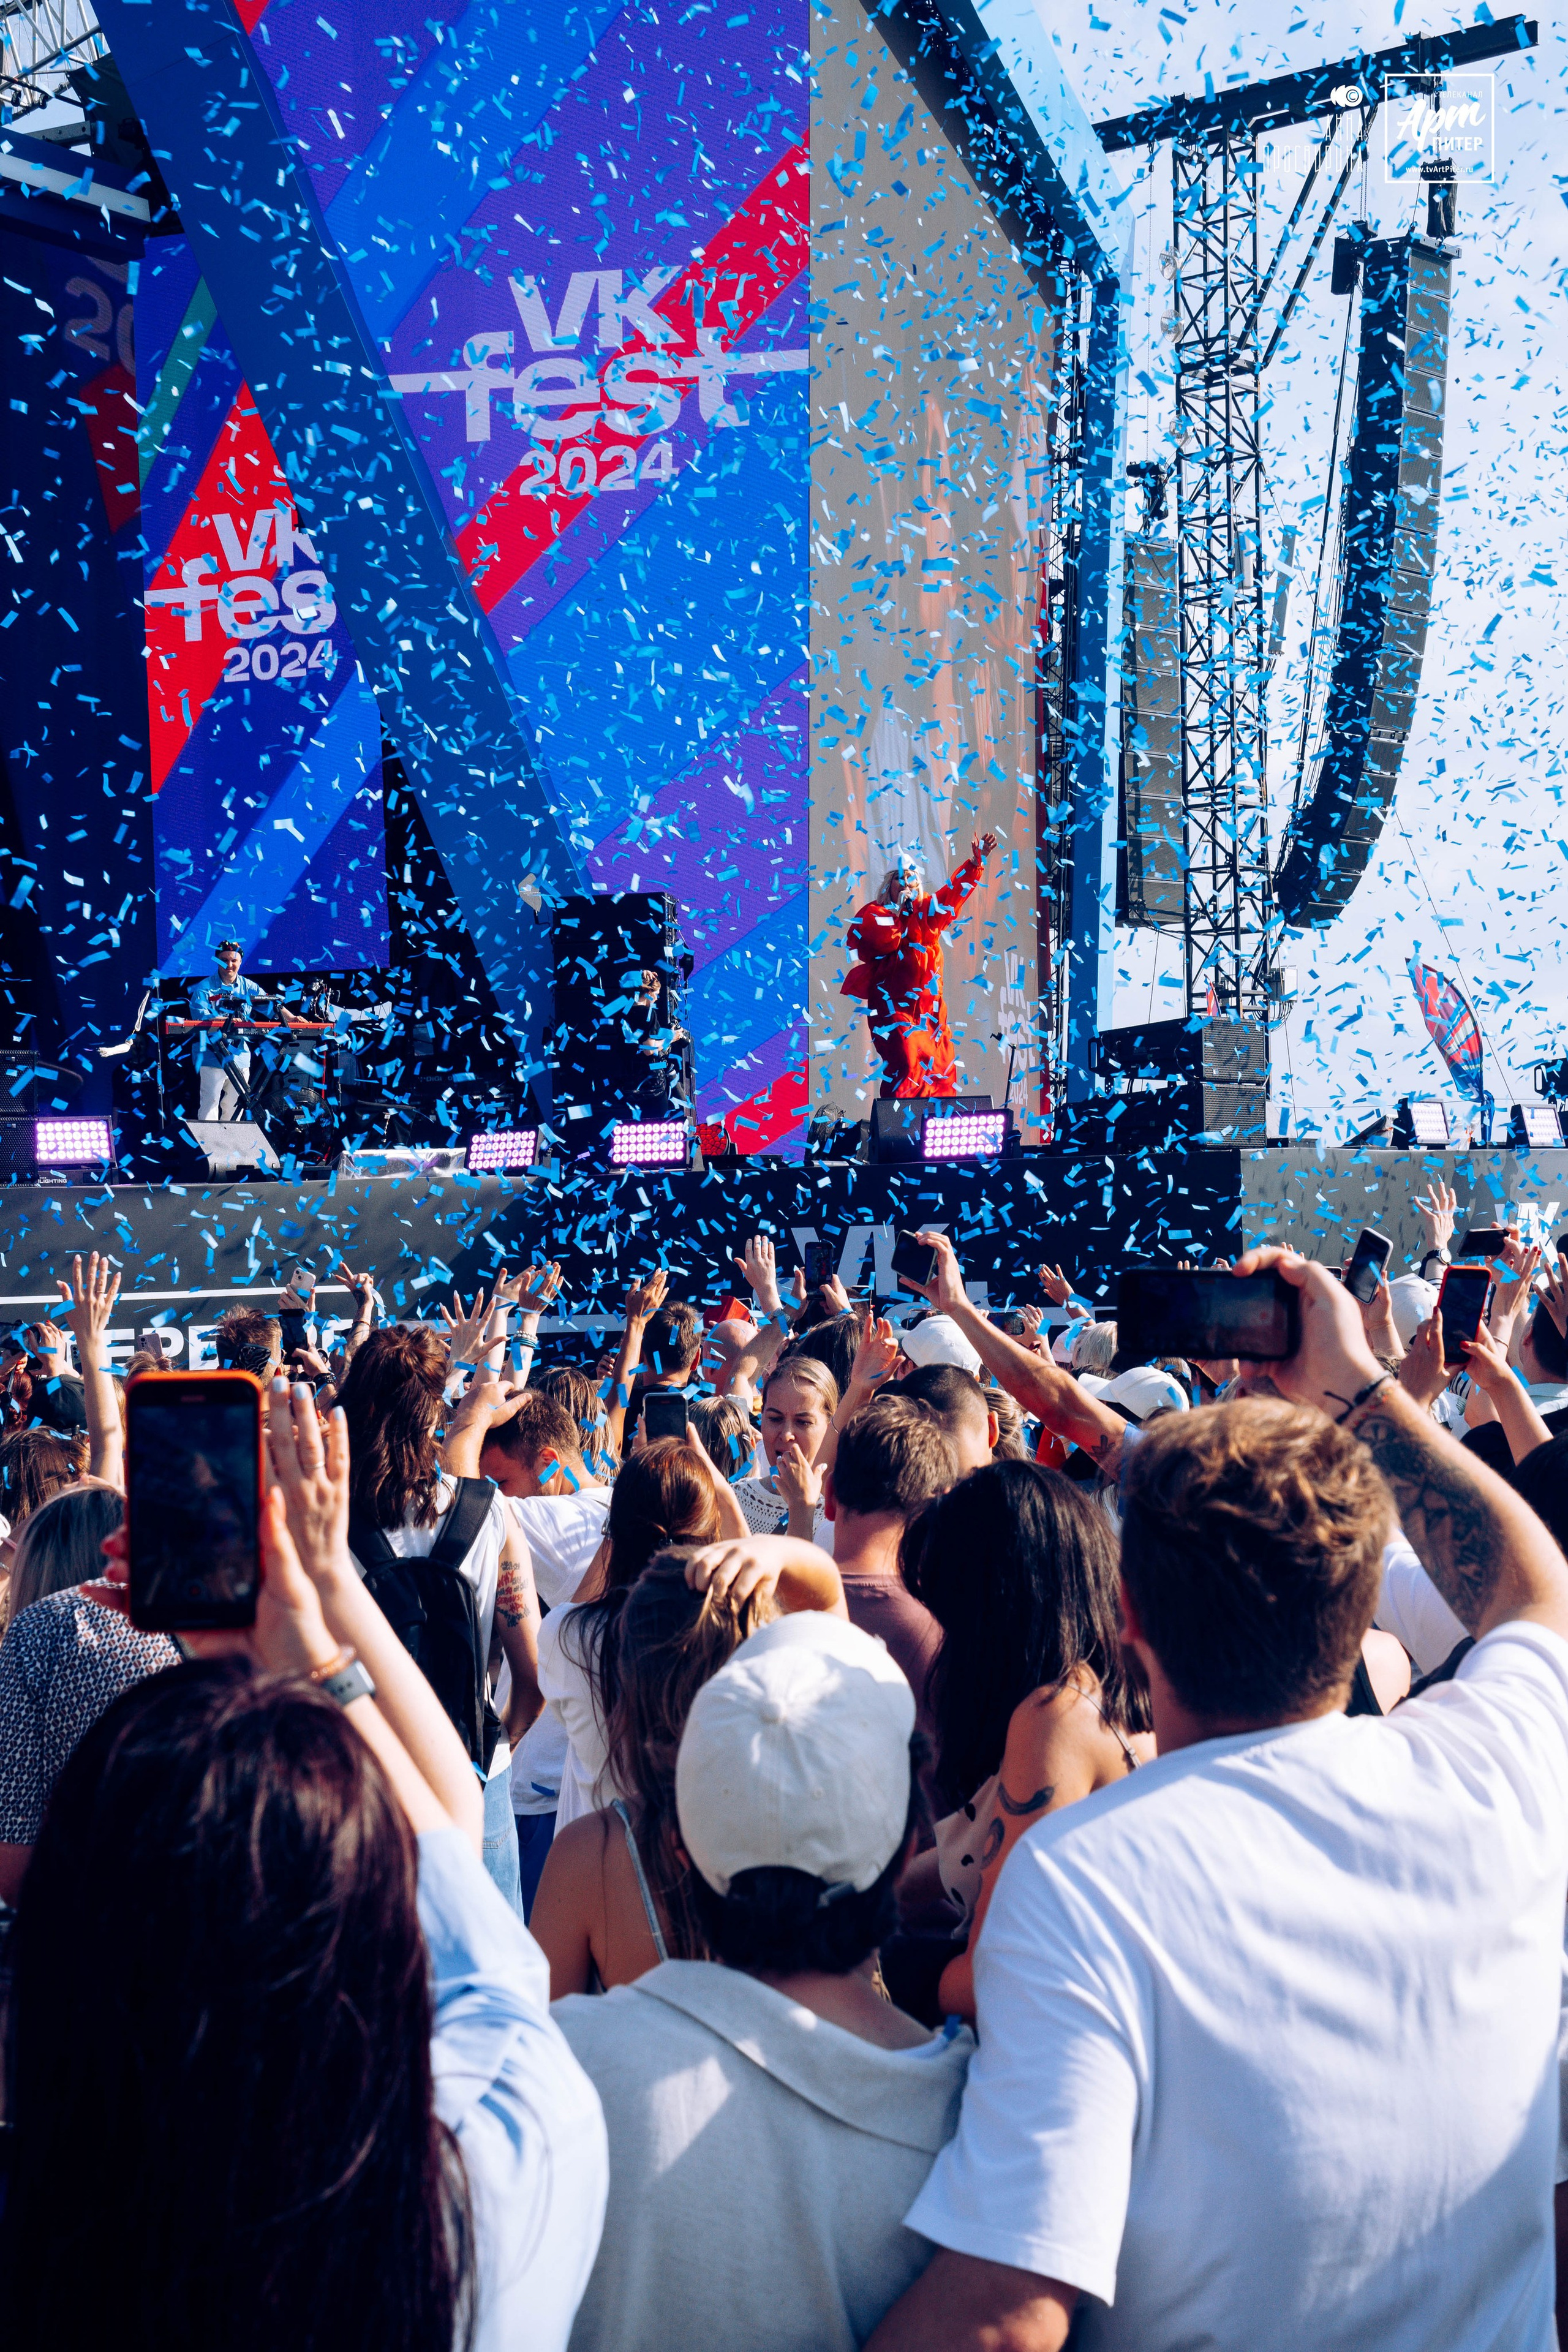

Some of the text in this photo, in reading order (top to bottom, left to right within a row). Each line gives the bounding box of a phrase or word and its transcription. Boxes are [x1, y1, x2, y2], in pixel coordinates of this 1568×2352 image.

[508, 265, 686, 353] VK
[388, 326, 810, 443] fest
[518, 442, 680, 496] 2024
[222, 639, 337, 683] 2024
